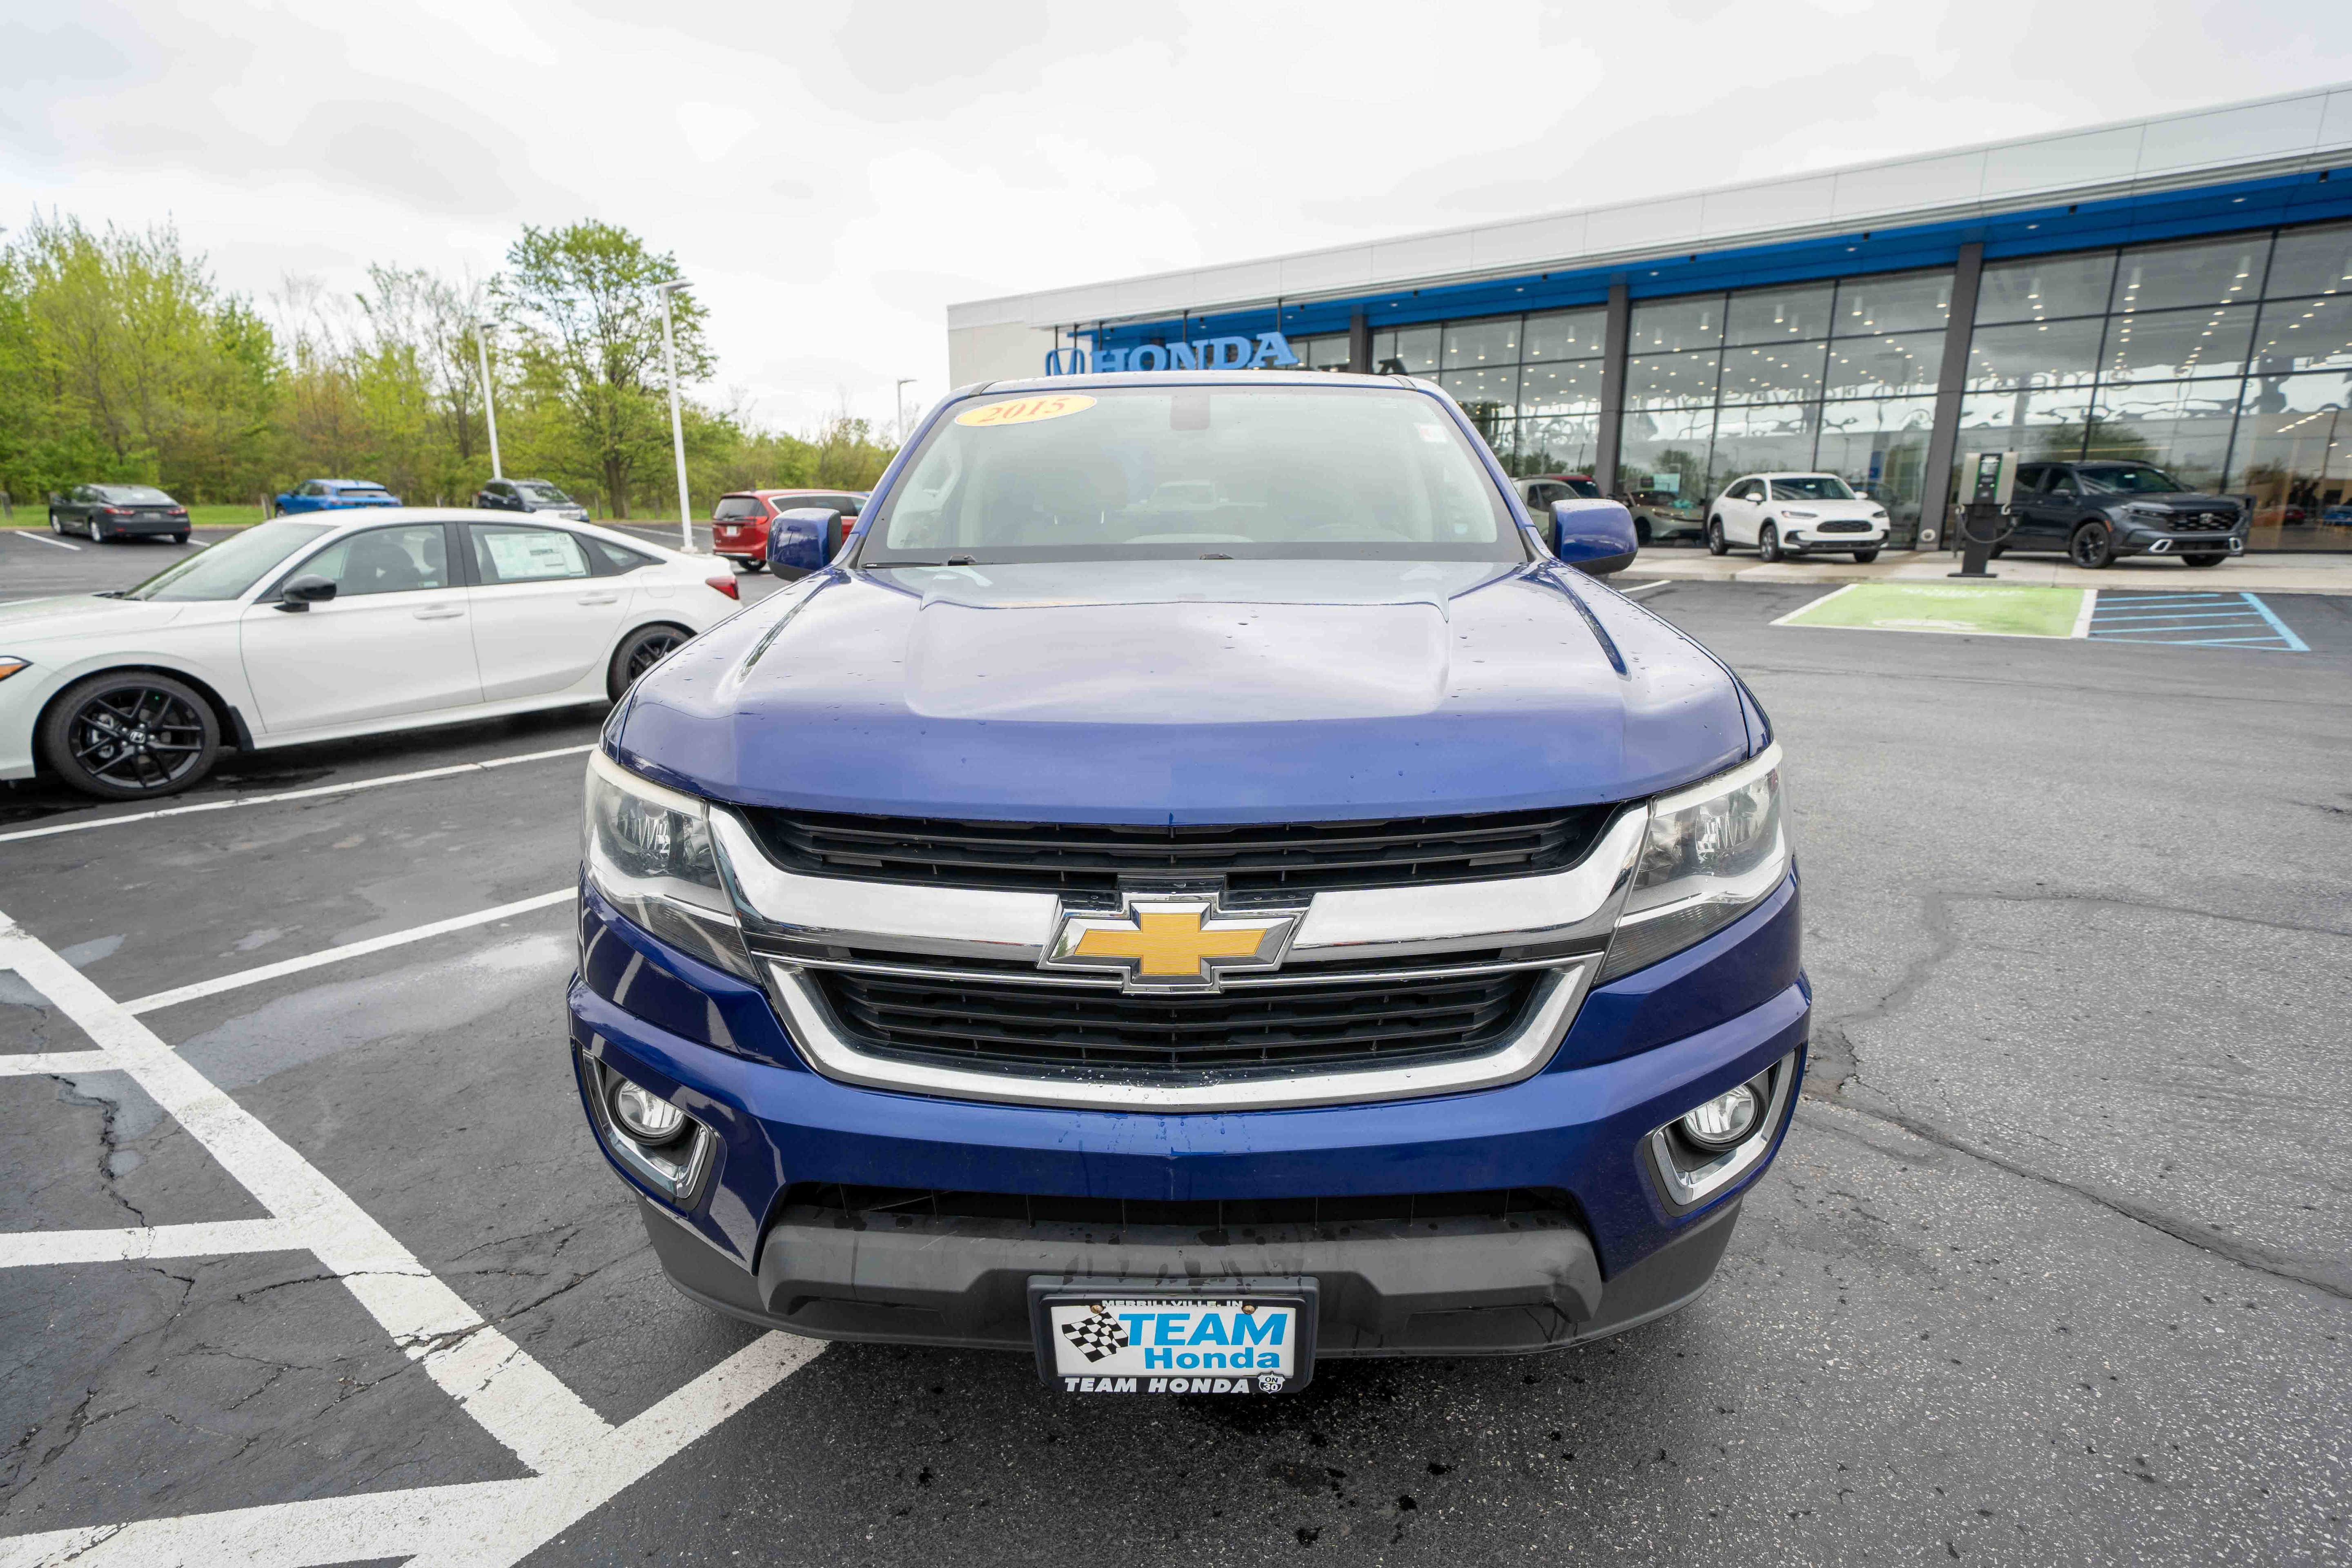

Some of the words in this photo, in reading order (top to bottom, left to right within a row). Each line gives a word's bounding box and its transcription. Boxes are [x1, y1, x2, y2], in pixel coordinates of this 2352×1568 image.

[1090, 332, 1299, 372] HONDA
[978, 398, 1070, 423] 2015
[1119, 1314, 1287, 1345] TEAM
[1145, 1348, 1280, 1369] Honda
[1065, 1378, 1137, 1392] TEAM
[1148, 1378, 1250, 1393] HONDA
